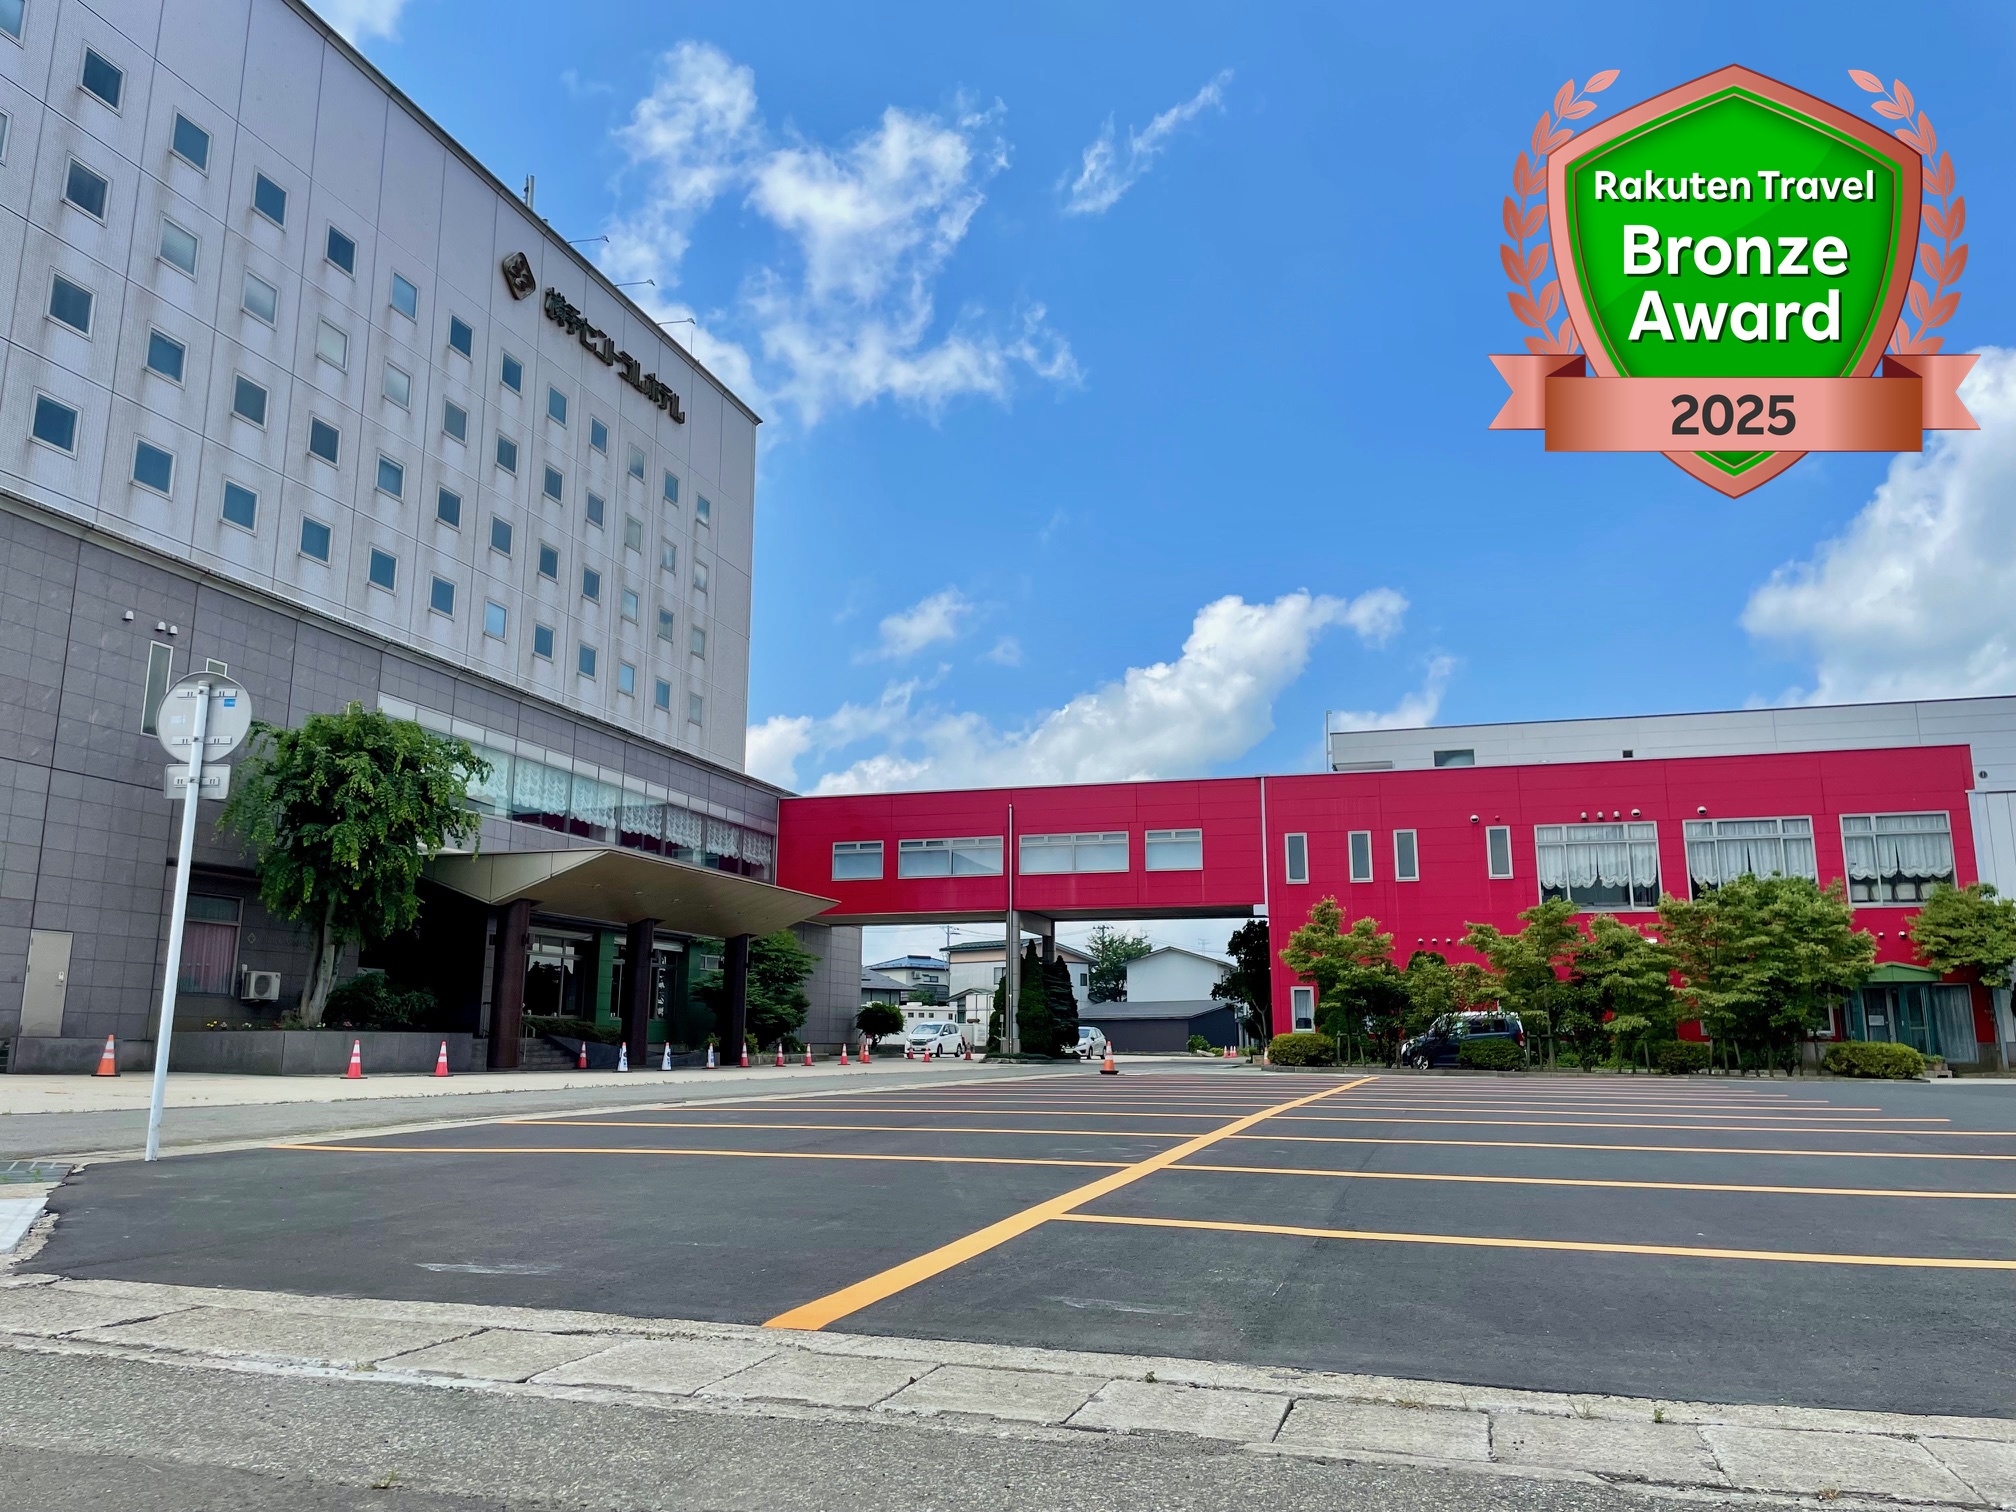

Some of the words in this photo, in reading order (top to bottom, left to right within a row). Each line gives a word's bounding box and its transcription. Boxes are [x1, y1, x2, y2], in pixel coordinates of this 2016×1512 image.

[545, 287, 685, 424] 横手セントラルホテル
